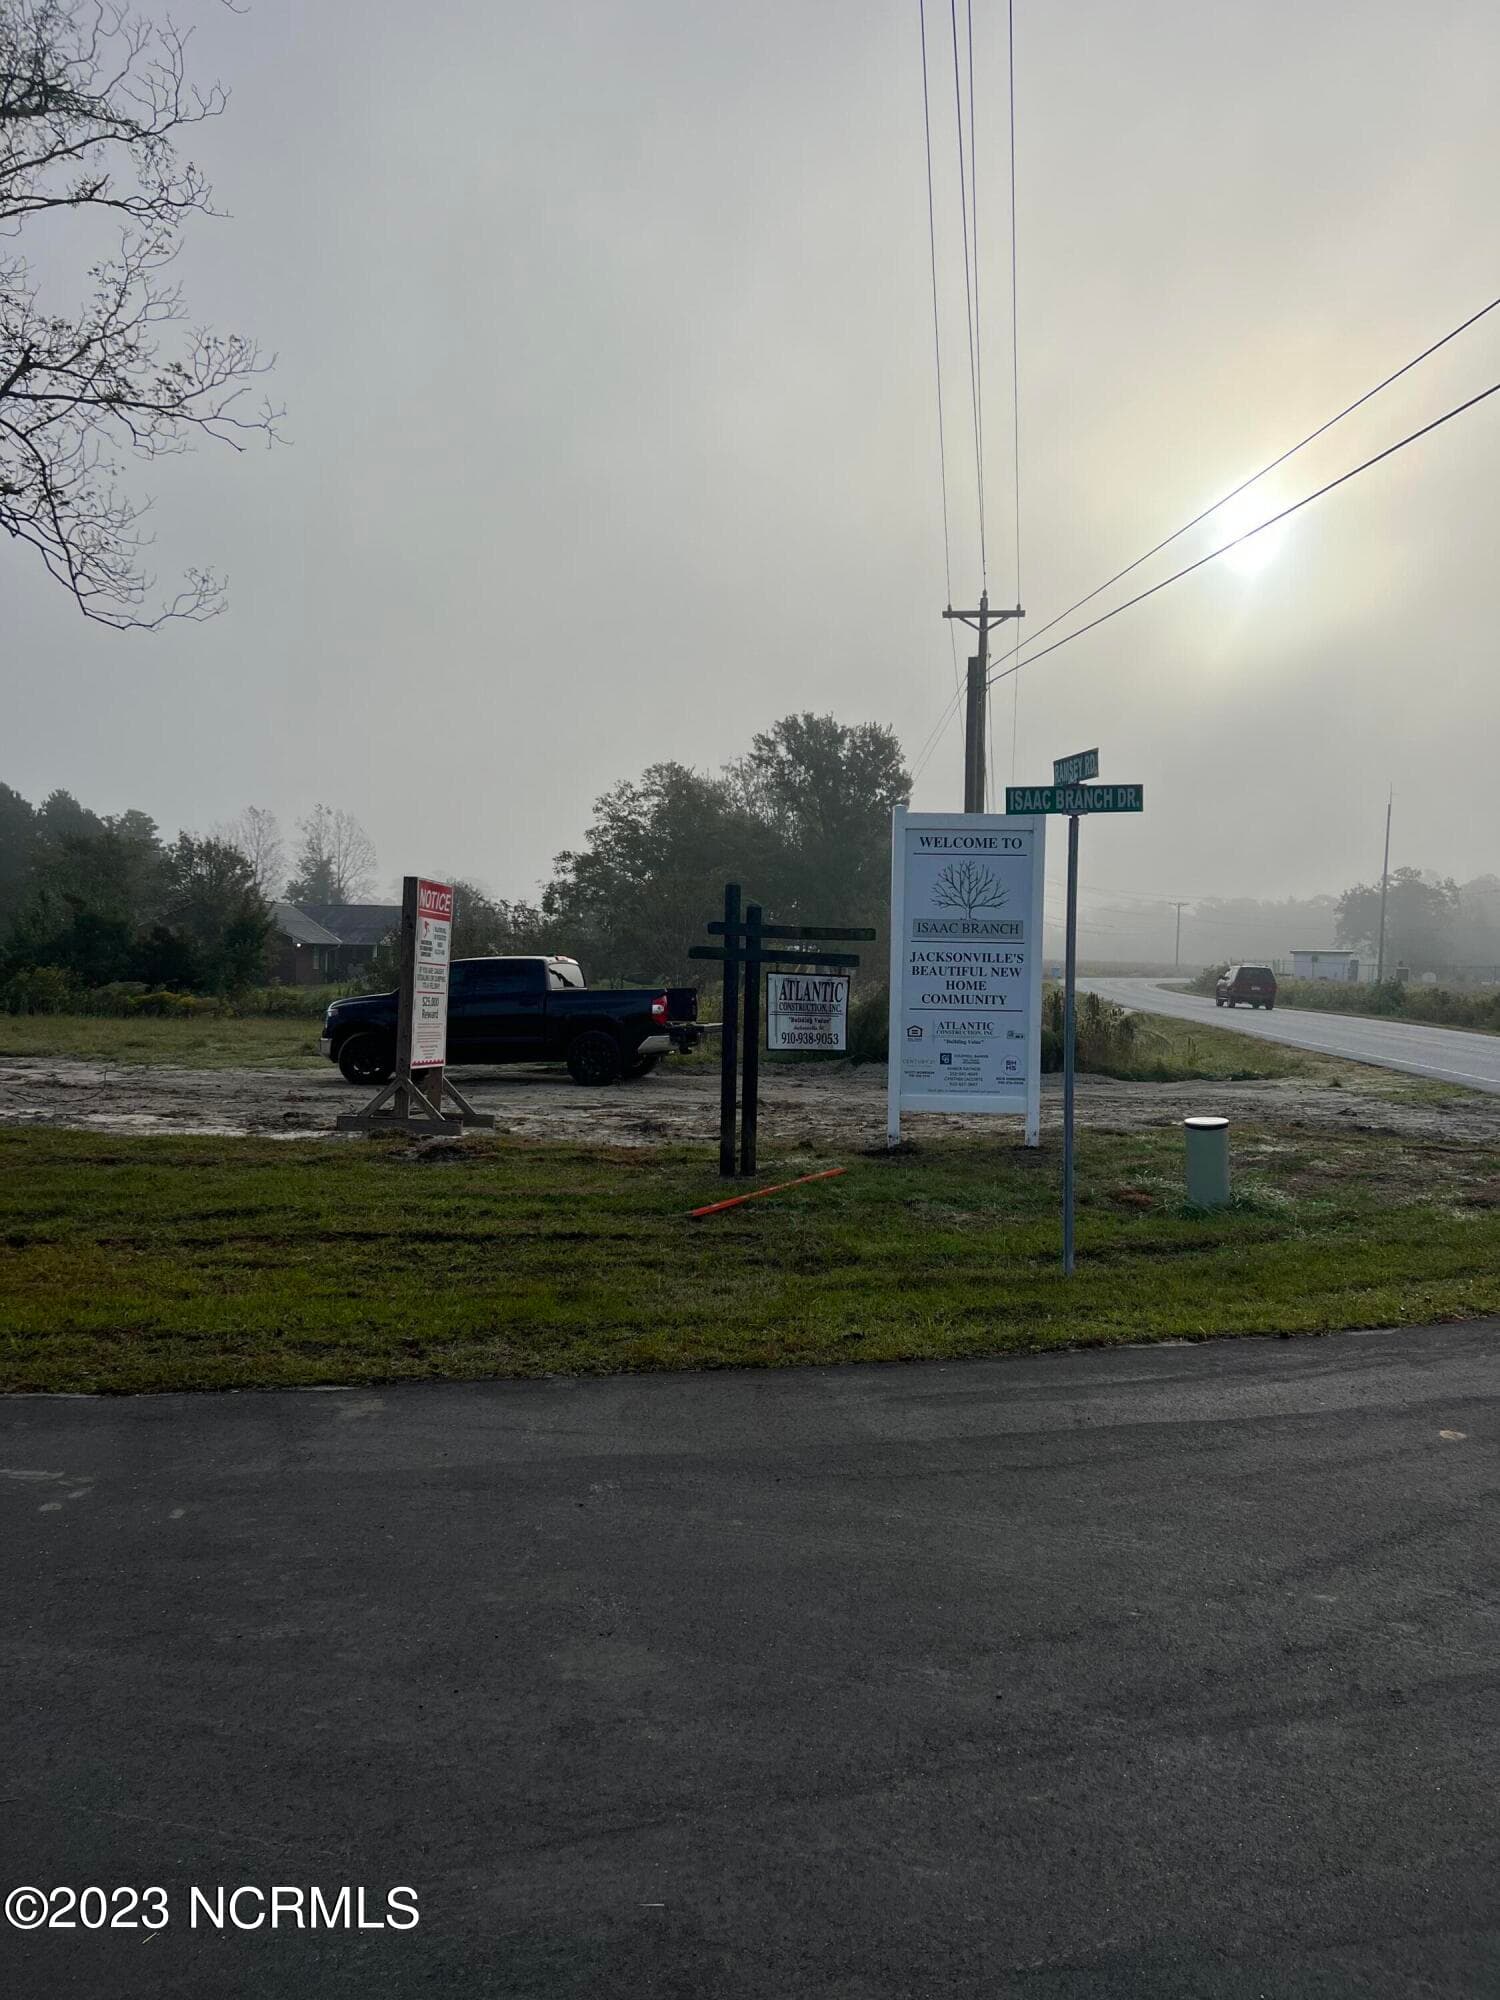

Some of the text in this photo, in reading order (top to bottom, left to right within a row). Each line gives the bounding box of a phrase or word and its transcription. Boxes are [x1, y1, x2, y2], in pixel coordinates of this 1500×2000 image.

[1054, 758, 1083, 784] RAMSEY
[1009, 788, 1140, 811] ISAAC BRANCH DR.
[919, 836, 1023, 849] WELCOME TO
[420, 888, 451, 912] NOTICE
[916, 922, 1019, 935] ISAAC BRANCH
[910, 951, 1025, 963] JACKSONVILLE'S
[911, 965, 1022, 978] BEAUTIFUL NEW
[779, 980, 844, 1003] ATLANTIC
[945, 980, 987, 991] HOME
[921, 993, 1008, 1005] COMMUNITY
[421, 1008, 439, 1018] Reward
[936, 1021, 995, 1030] ATLANTIC
[781, 1031, 840, 1045] 910-938-9053
